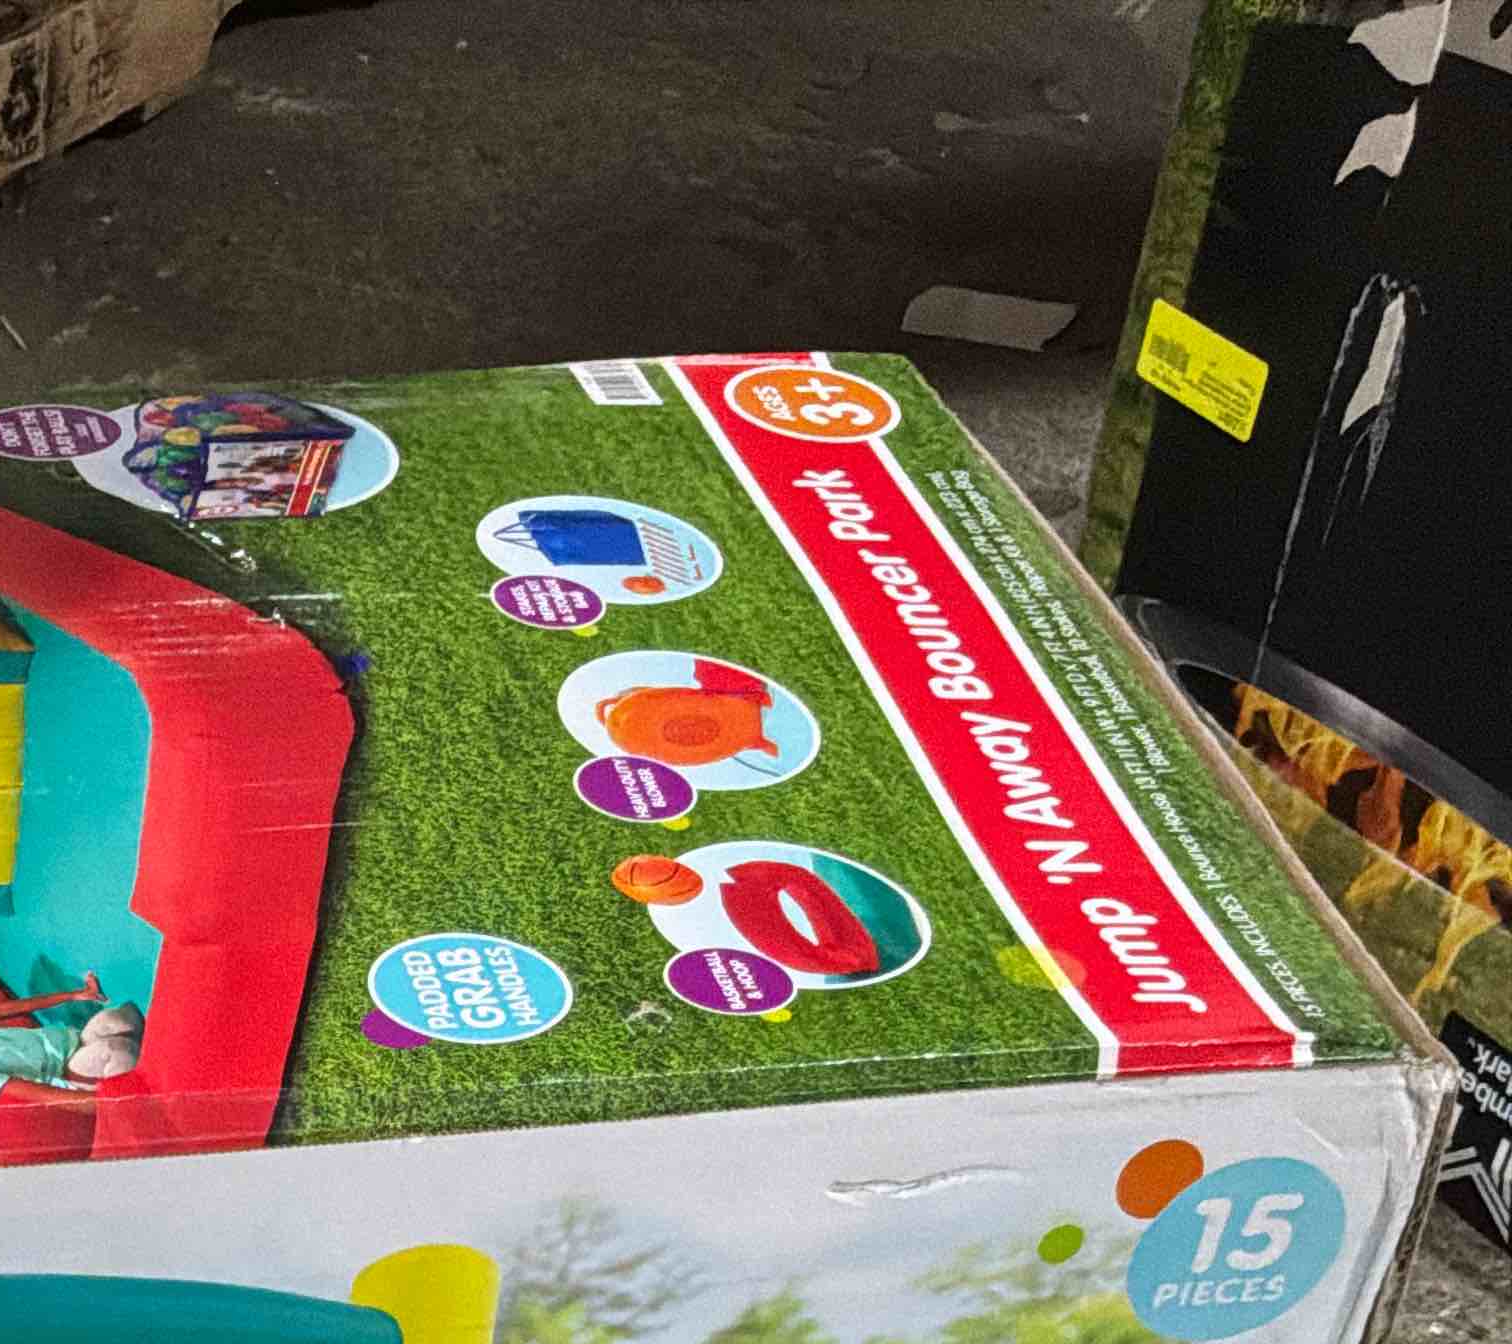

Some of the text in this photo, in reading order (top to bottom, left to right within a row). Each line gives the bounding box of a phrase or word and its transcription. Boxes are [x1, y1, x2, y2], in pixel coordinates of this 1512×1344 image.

[752, 384, 797, 421] AGES
[793, 377, 875, 426] 3+
[792, 469, 1208, 1012] Jump 'N Away Bouncer Park
[612, 759, 651, 817] HEAVY-DUTY
[637, 767, 666, 807] BLOWER
[1150, 792, 1188, 833] House
[402, 951, 459, 1029] PADDED
[437, 947, 506, 1029] GRAB
[485, 945, 541, 1026] HANDLES
[704, 952, 747, 1010] BASKETBALL
[729, 959, 758, 989] HOOP
[1473, 1043, 1512, 1096] ark
[1191, 1191, 1305, 1273] 15
[1152, 1276, 1287, 1309] PIECES
